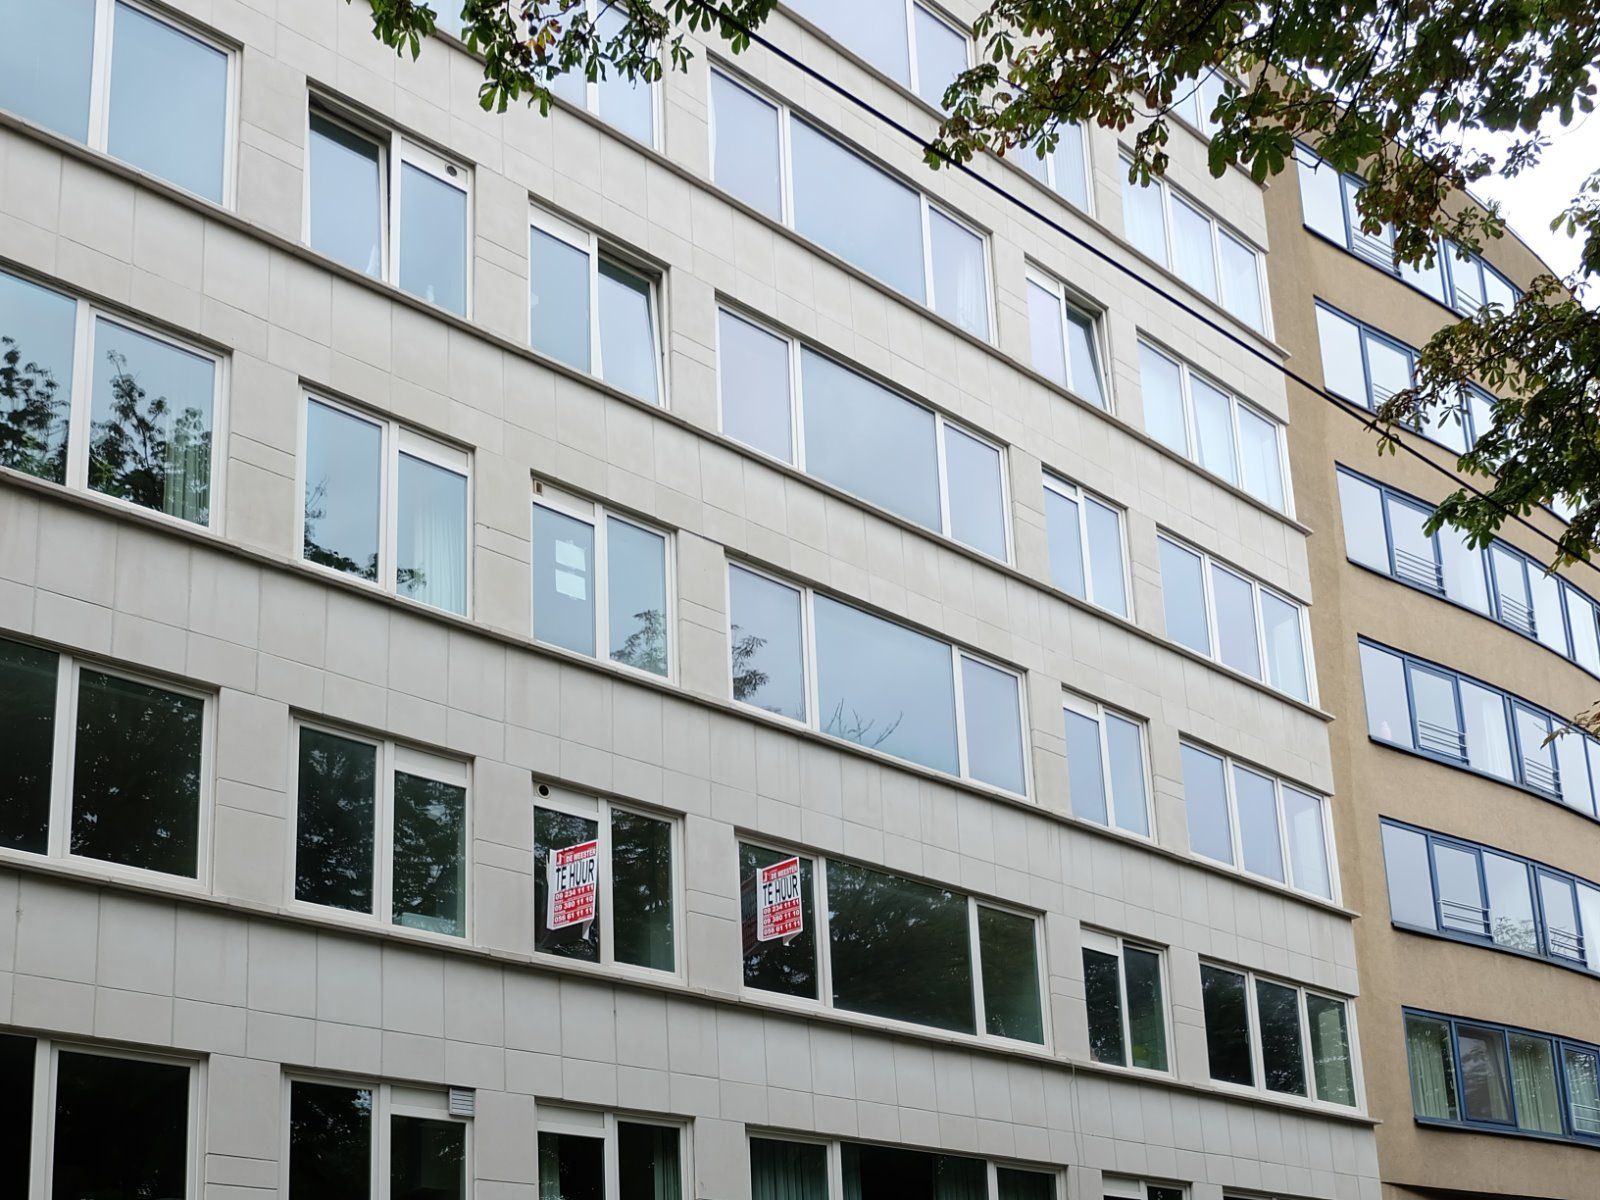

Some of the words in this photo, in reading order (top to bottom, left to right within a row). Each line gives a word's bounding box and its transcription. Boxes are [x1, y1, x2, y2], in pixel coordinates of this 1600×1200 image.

[556, 866, 566, 890] TE
[569, 859, 594, 888] HUUR
[577, 886, 584, 894] 11
[587, 883, 594, 891] 11
[763, 883, 773, 905] TE
[775, 876, 798, 902] HUUR
[576, 897, 584, 905] 11
[585, 895, 593, 903] 10
[784, 901, 791, 909] 11
[792, 898, 799, 906] 11
[585, 906, 592, 914] 11
[784, 911, 791, 919] 11
[793, 909, 800, 917] 10
[785, 922, 792, 930] 11
[793, 920, 800, 928] 11
